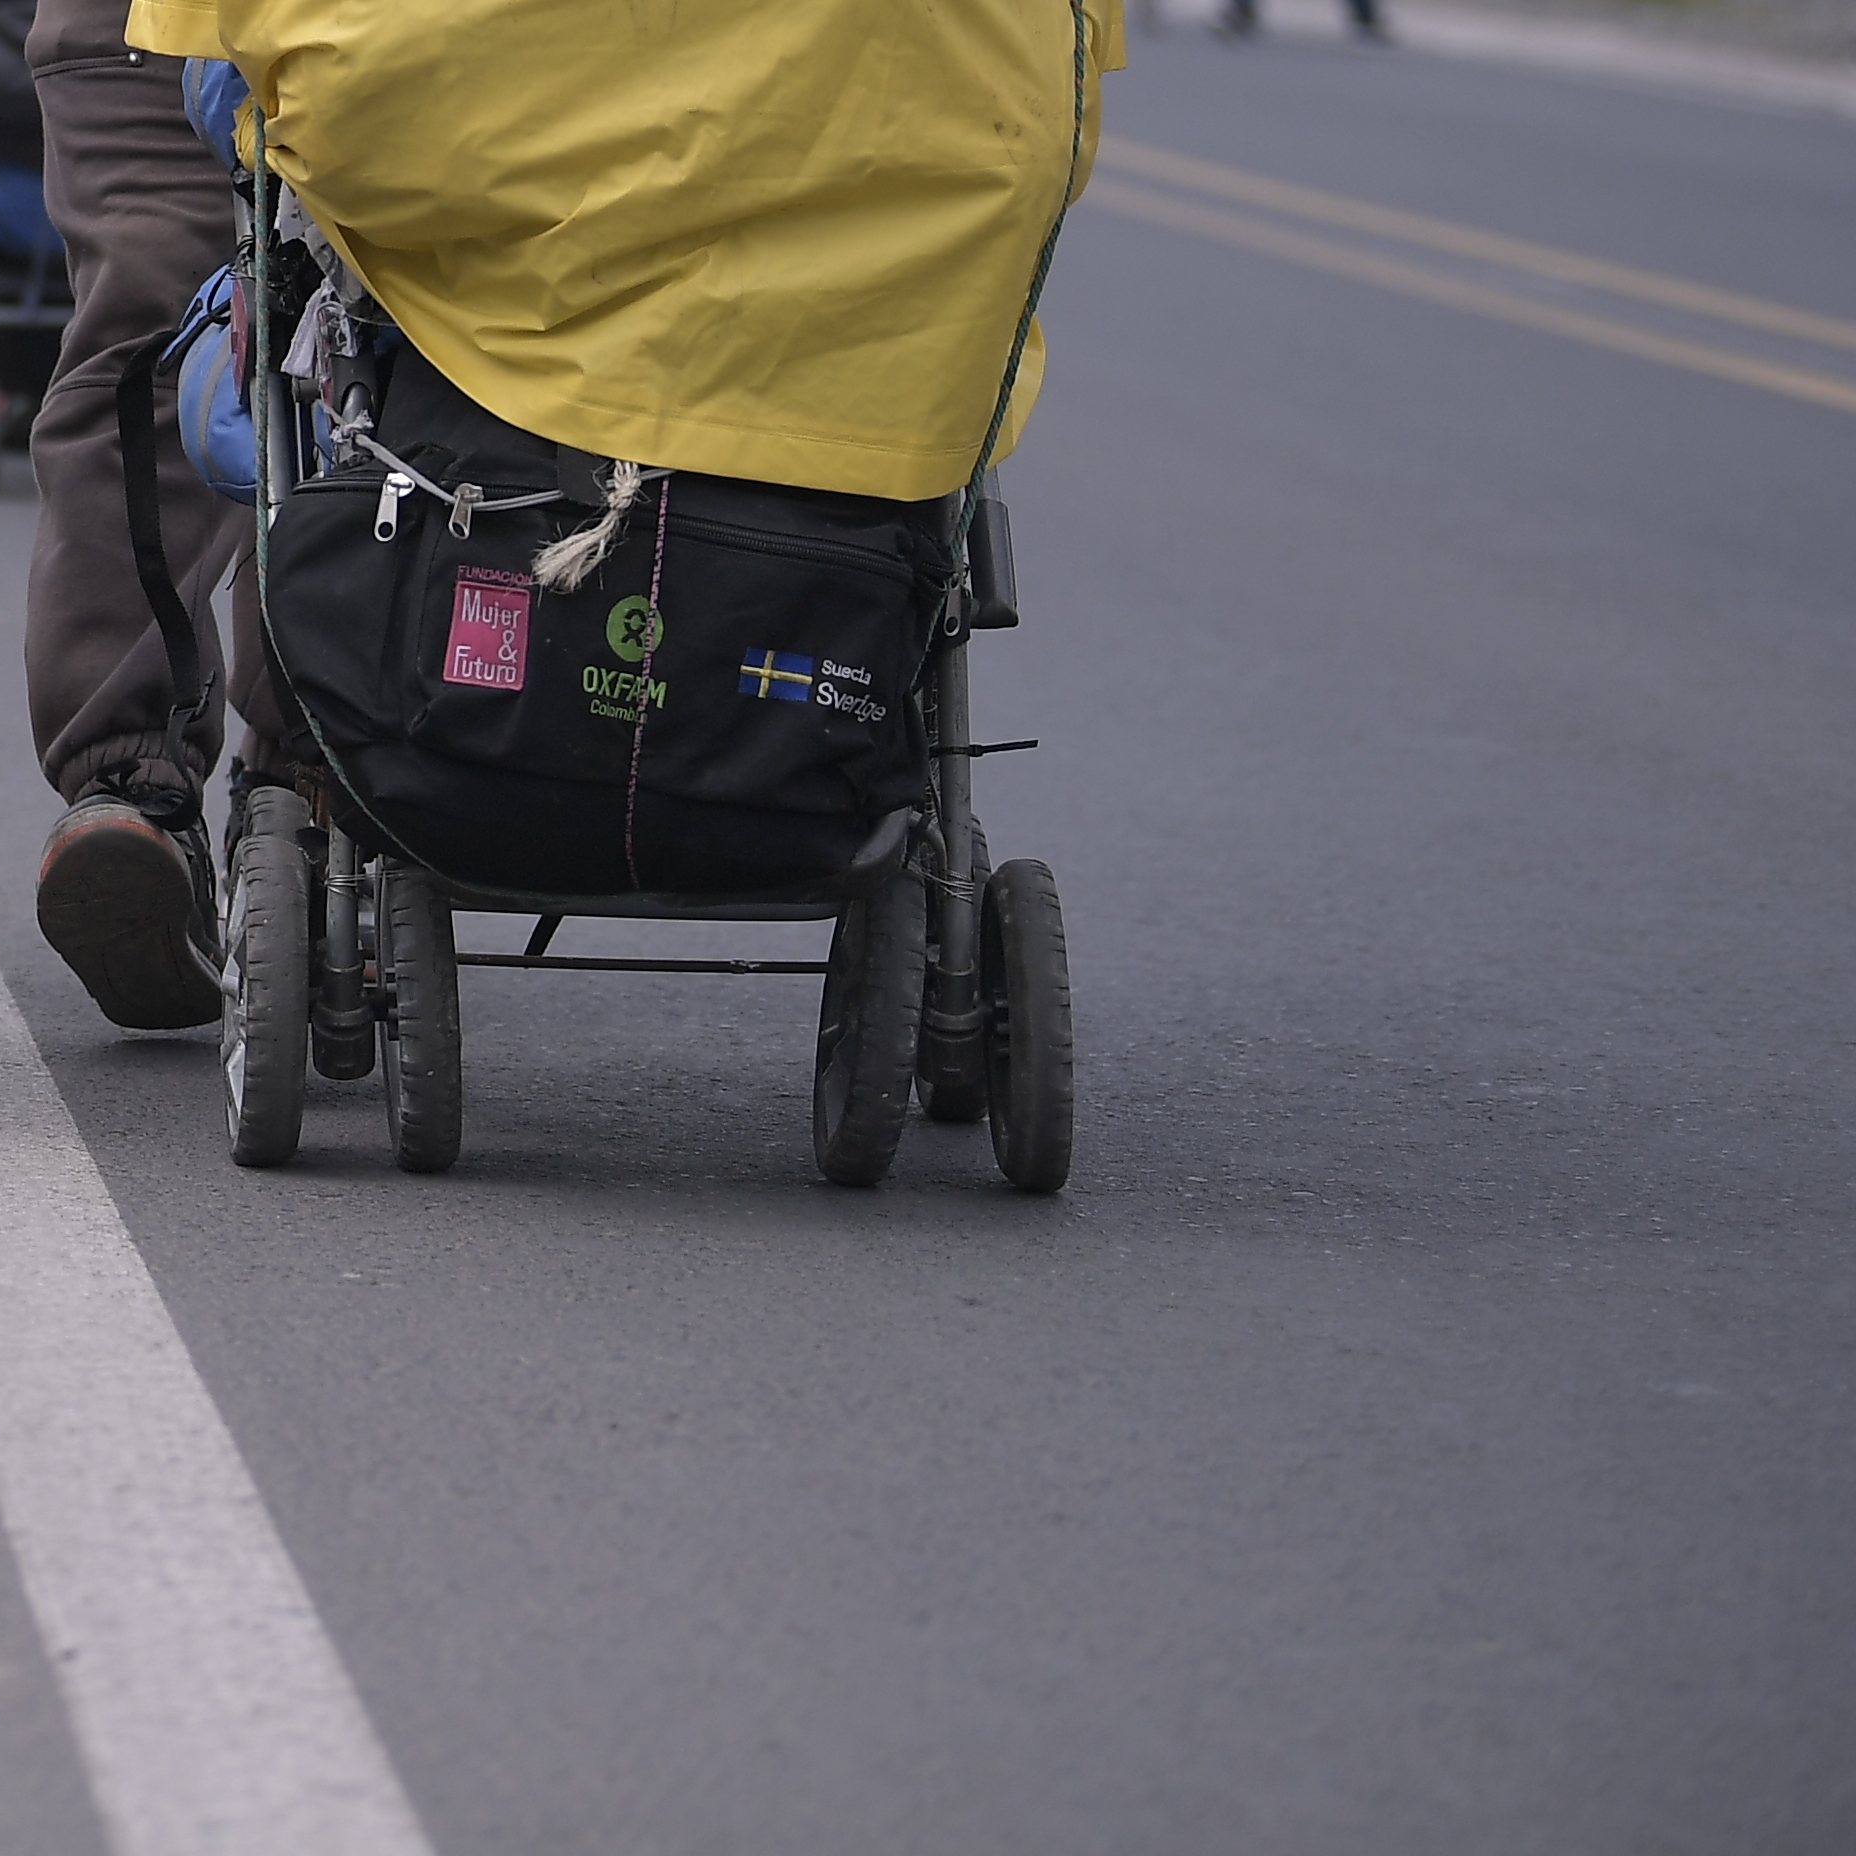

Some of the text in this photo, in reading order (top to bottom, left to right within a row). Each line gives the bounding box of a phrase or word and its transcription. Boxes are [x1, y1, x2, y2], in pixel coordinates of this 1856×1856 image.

[461, 587, 522, 630] Mujer
[453, 645, 517, 683] Futuro
[498, 629, 518, 663] &
[582, 665, 668, 710] OXFAM
[821, 659, 872, 685] Suecia
[816, 681, 887, 722] Sverige
